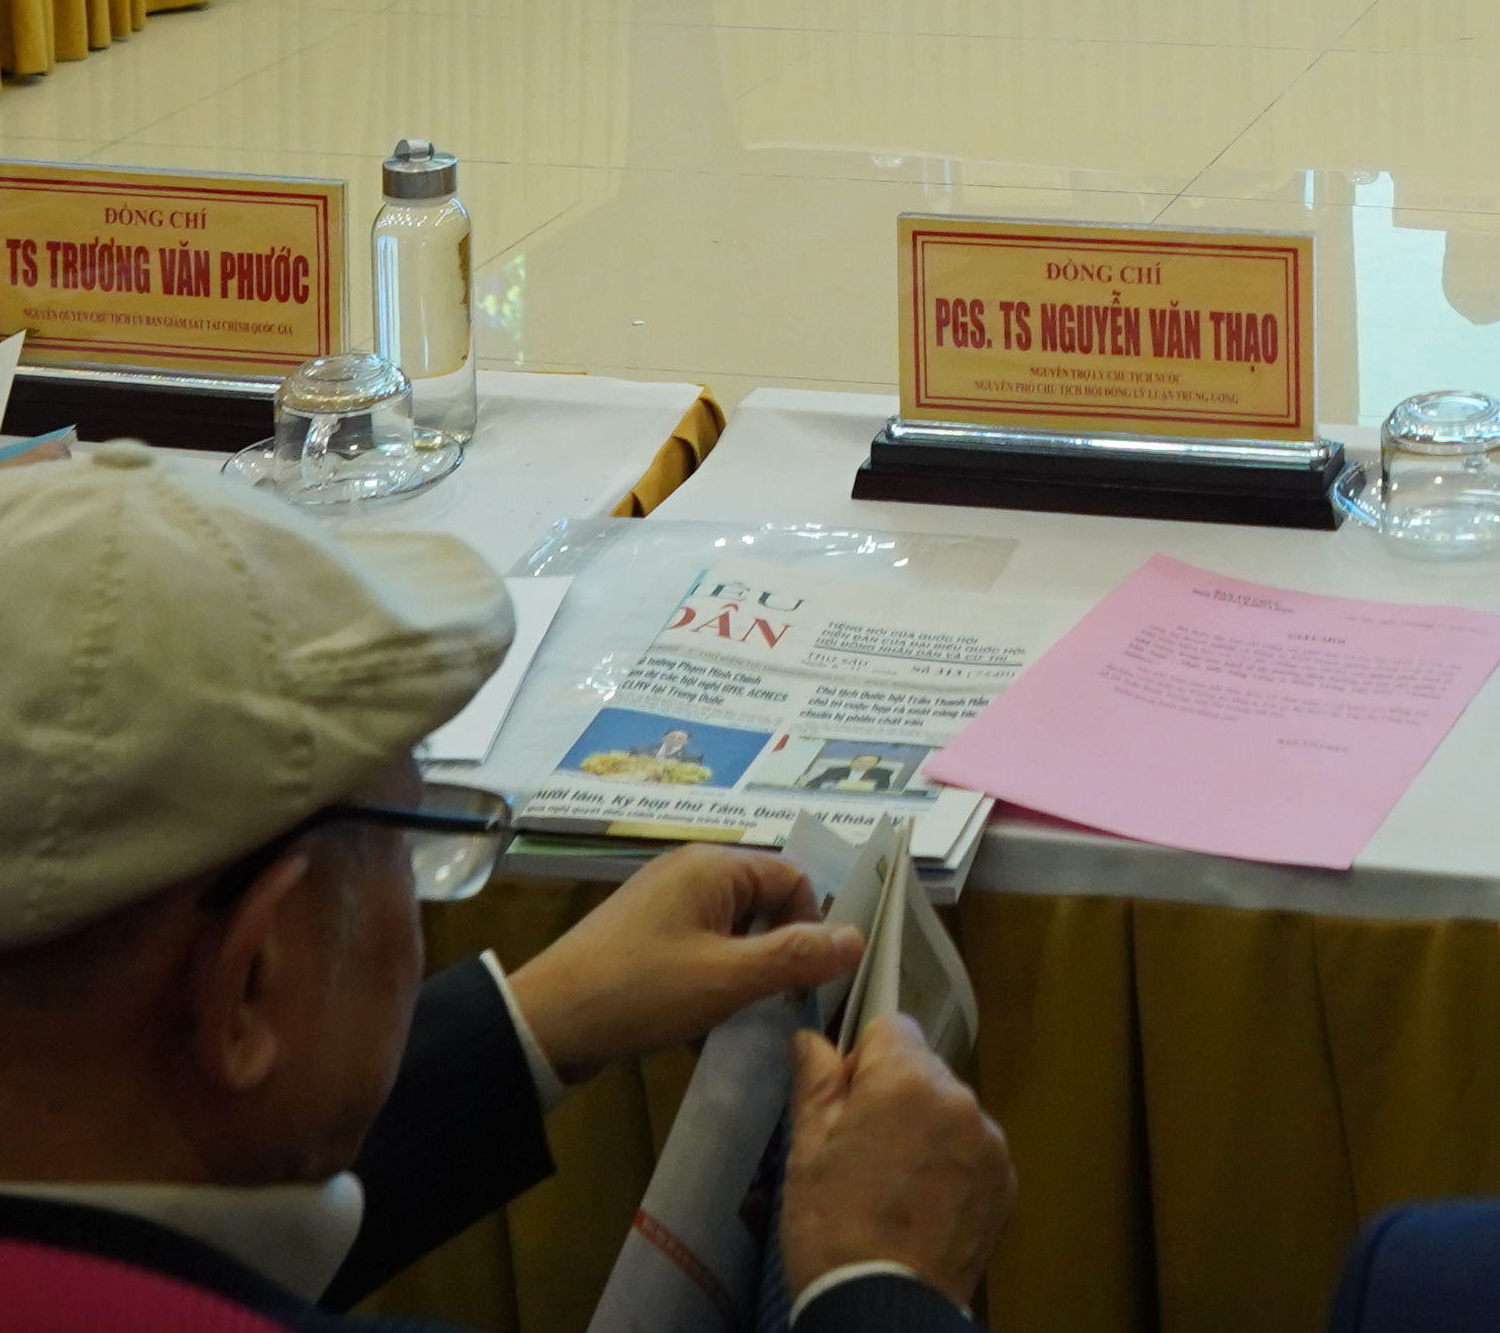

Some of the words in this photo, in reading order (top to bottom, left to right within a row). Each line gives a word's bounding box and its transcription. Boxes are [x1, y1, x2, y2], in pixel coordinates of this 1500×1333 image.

[103, 202, 164, 228] ĐỒNG
[170, 207, 207, 230] CHÍ
[6, 238, 38, 288] TS
[46, 236, 151, 294] TRƯƠNG
[159, 240, 211, 298] VĂN
[220, 245, 310, 305] PHƯỚC
[1046, 258, 1112, 284] ĐỒNG
[1120, 262, 1162, 285] CHÍ
[935, 297, 992, 350] PGS.
[1000, 301, 1032, 351] TS
[1040, 290, 1141, 357] NGUYỄN
[1150, 299, 1201, 360] VĂN
[1210, 311, 1279, 373] THẠO
